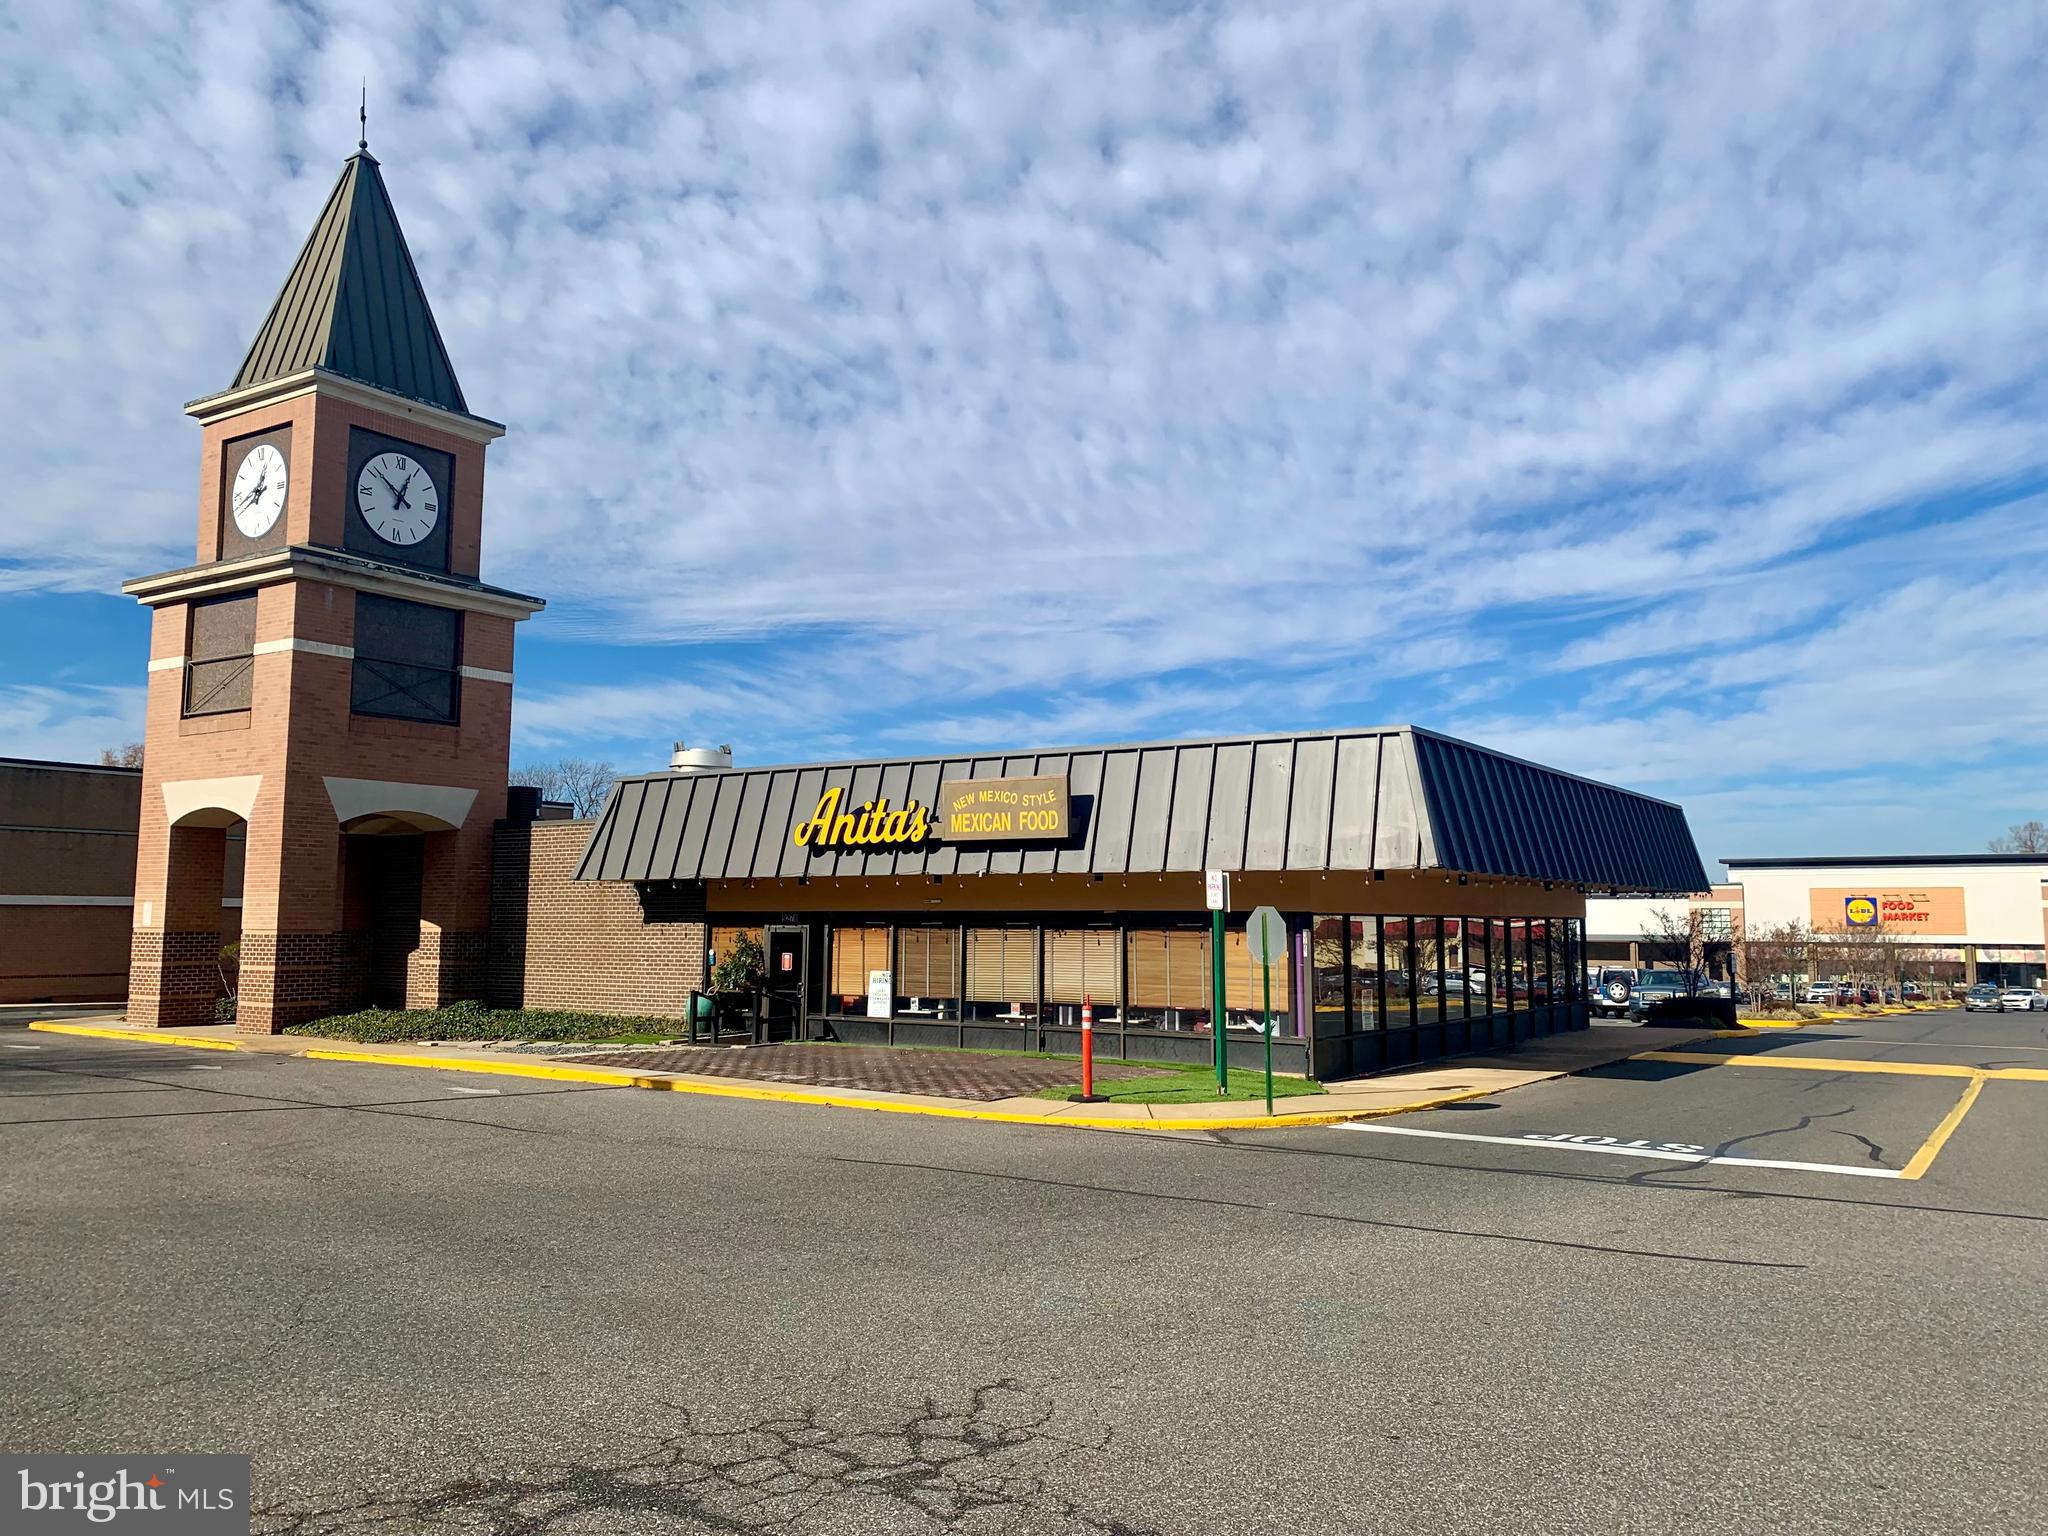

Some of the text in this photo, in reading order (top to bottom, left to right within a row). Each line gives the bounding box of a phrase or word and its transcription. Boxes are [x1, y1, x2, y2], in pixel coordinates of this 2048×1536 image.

[952, 789, 1057, 811] NEW MEXICO STYLE
[794, 786, 928, 847] Anita's
[951, 810, 1059, 833] MEXICAN FOOD
[1882, 902, 1914, 911] FOOD
[1882, 912, 1930, 922] MARKET
[1523, 1133, 1705, 1153] STOP
